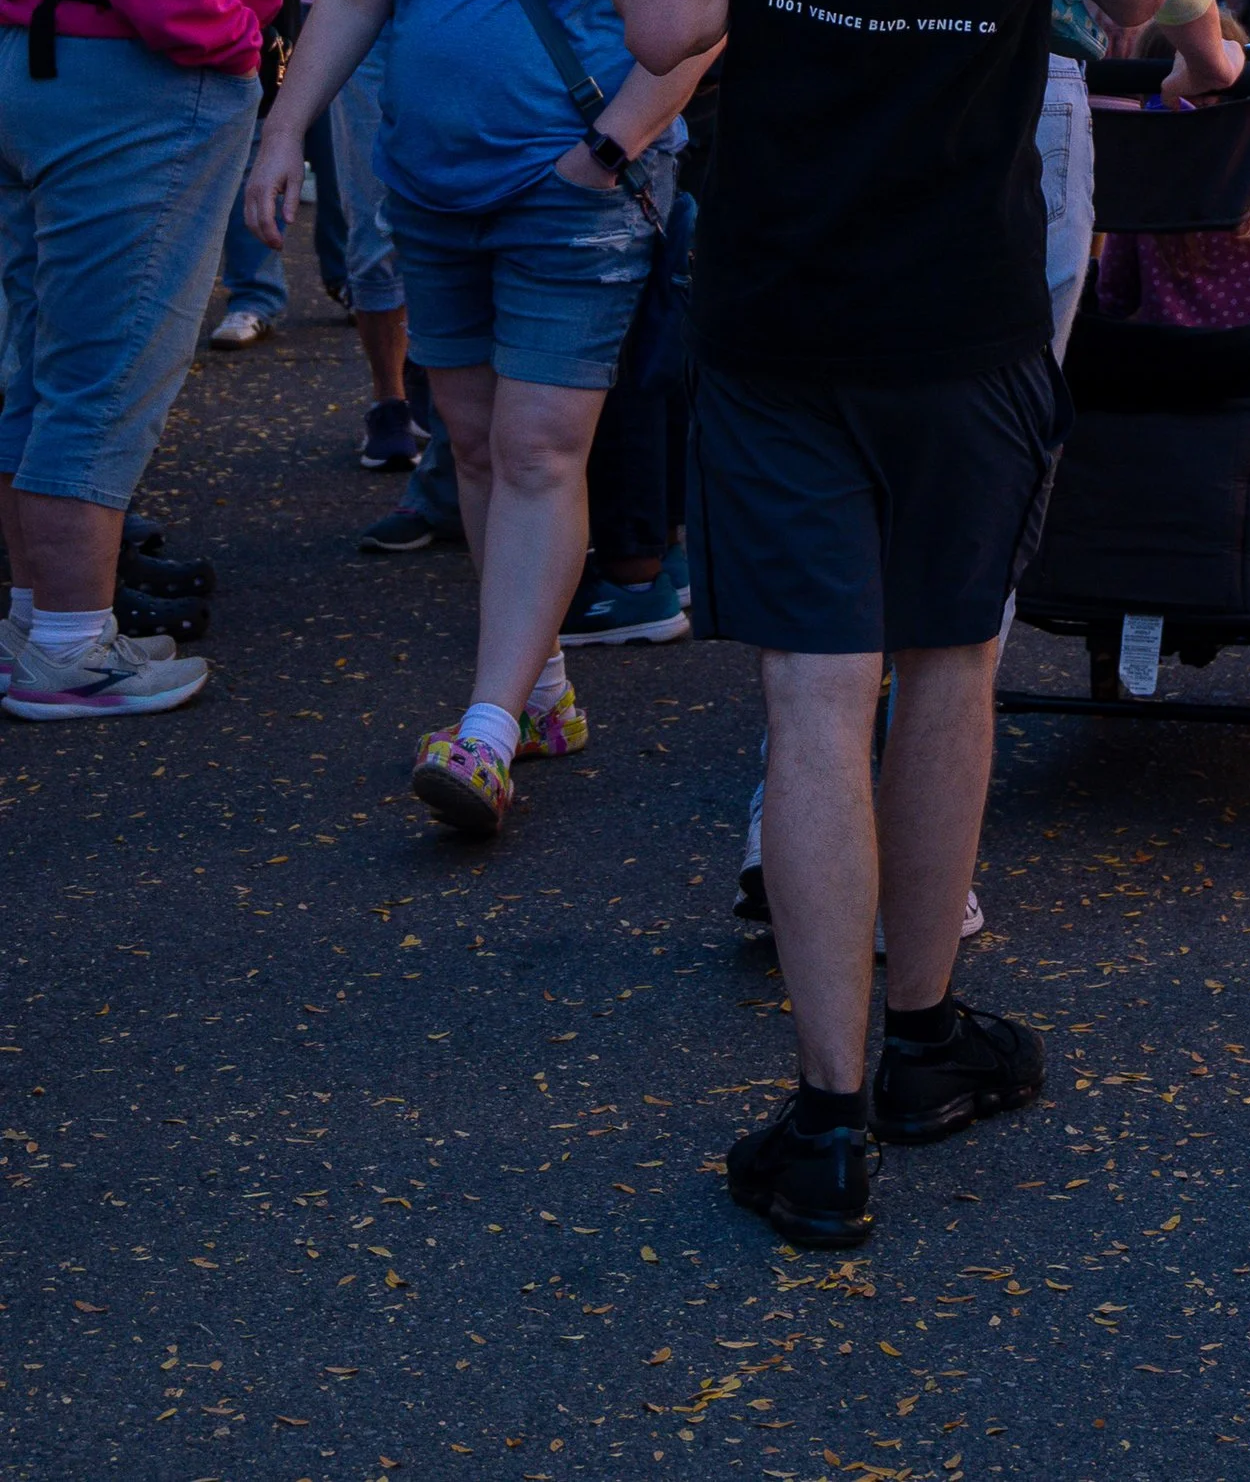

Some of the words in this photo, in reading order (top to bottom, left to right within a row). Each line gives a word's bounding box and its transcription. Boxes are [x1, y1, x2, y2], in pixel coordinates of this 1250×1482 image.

[809, 5, 862, 29] VENICE
[869, 19, 911, 31] BLVD.
[917, 19, 972, 32] VENICE
